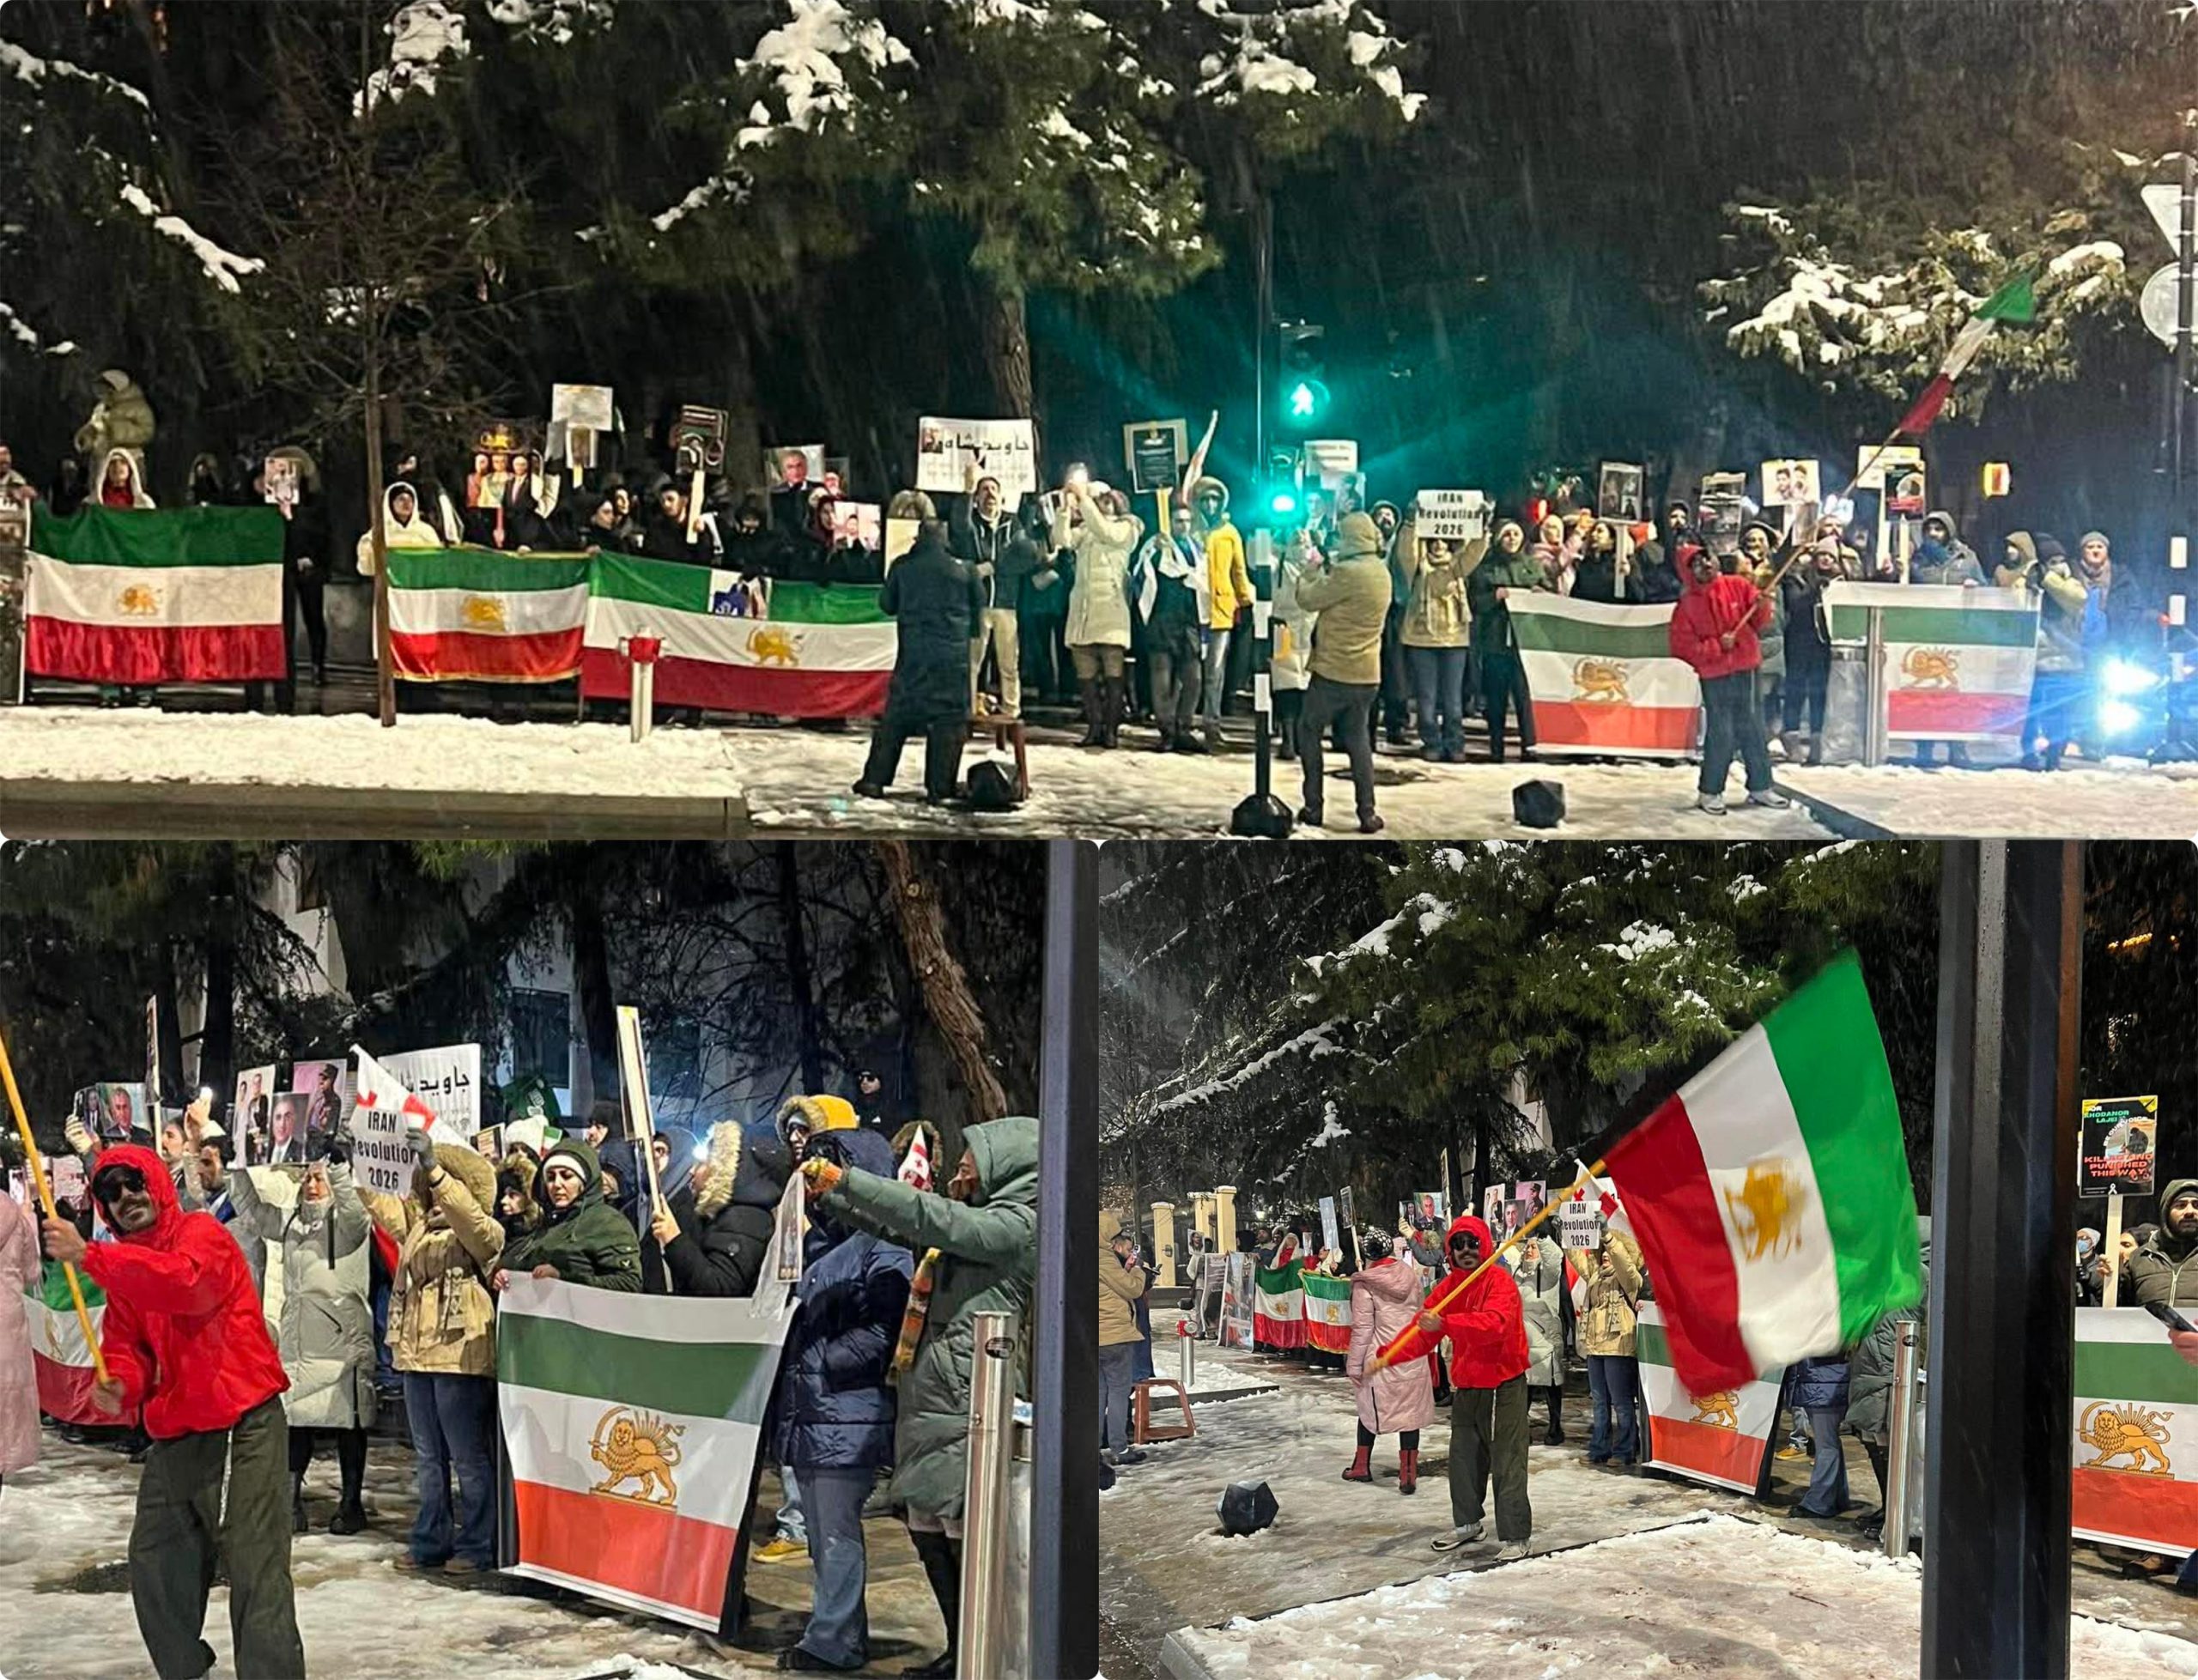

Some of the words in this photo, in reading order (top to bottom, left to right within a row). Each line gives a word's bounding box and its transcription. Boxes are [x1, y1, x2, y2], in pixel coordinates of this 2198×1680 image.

[1437, 493, 1463, 504] IRAN
[1434, 524, 1464, 536] 2026
[367, 1110, 398, 1134] IRAN
[355, 1139, 416, 1164] evolution
[367, 1167, 399, 1190] 2026
[2117, 1168, 2145, 1177] WAY
[1569, 1203, 1587, 1215] IRAN
[1563, 1219, 1600, 1230] evolution
[1570, 1234, 1590, 1246] 2026
